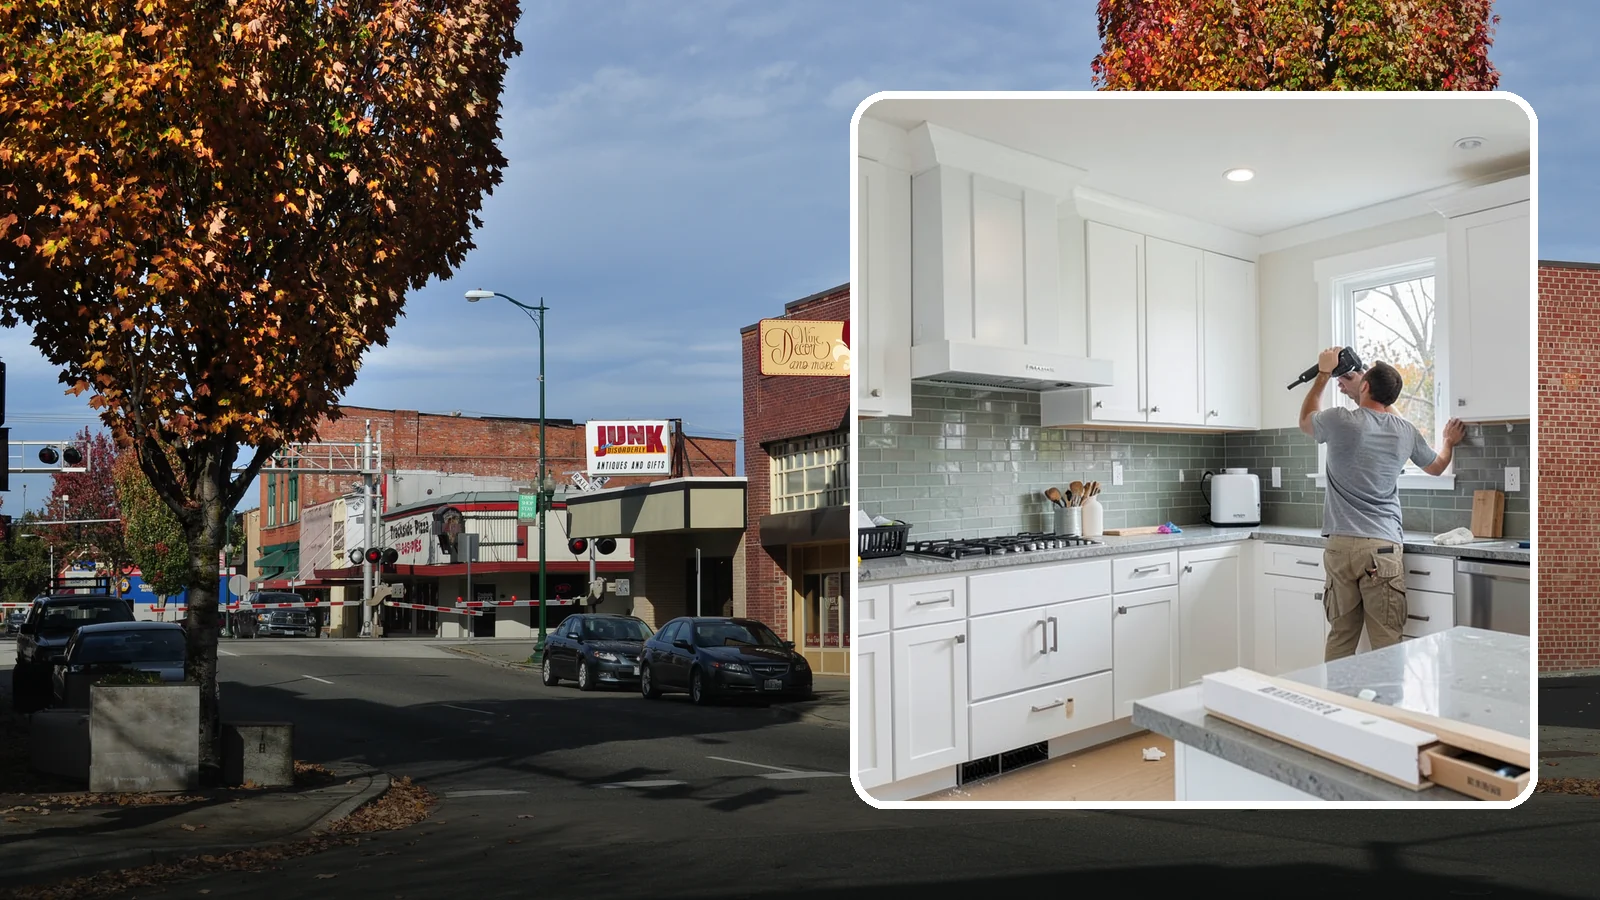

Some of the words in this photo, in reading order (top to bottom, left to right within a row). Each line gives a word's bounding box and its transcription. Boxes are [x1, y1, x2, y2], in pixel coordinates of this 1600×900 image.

[765, 328, 831, 365] Decor
[595, 425, 665, 457] JUNK
[607, 446, 646, 454] DISORDERLY
[597, 461, 628, 470] ANTIQUES
[631, 461, 644, 469] AND
[647, 460, 665, 469] GIFTS
[573, 473, 589, 492] RAIL
[352, 498, 364, 510] CRO
[390, 521, 413, 539] Trackside
[414, 519, 429, 535] Pizza
